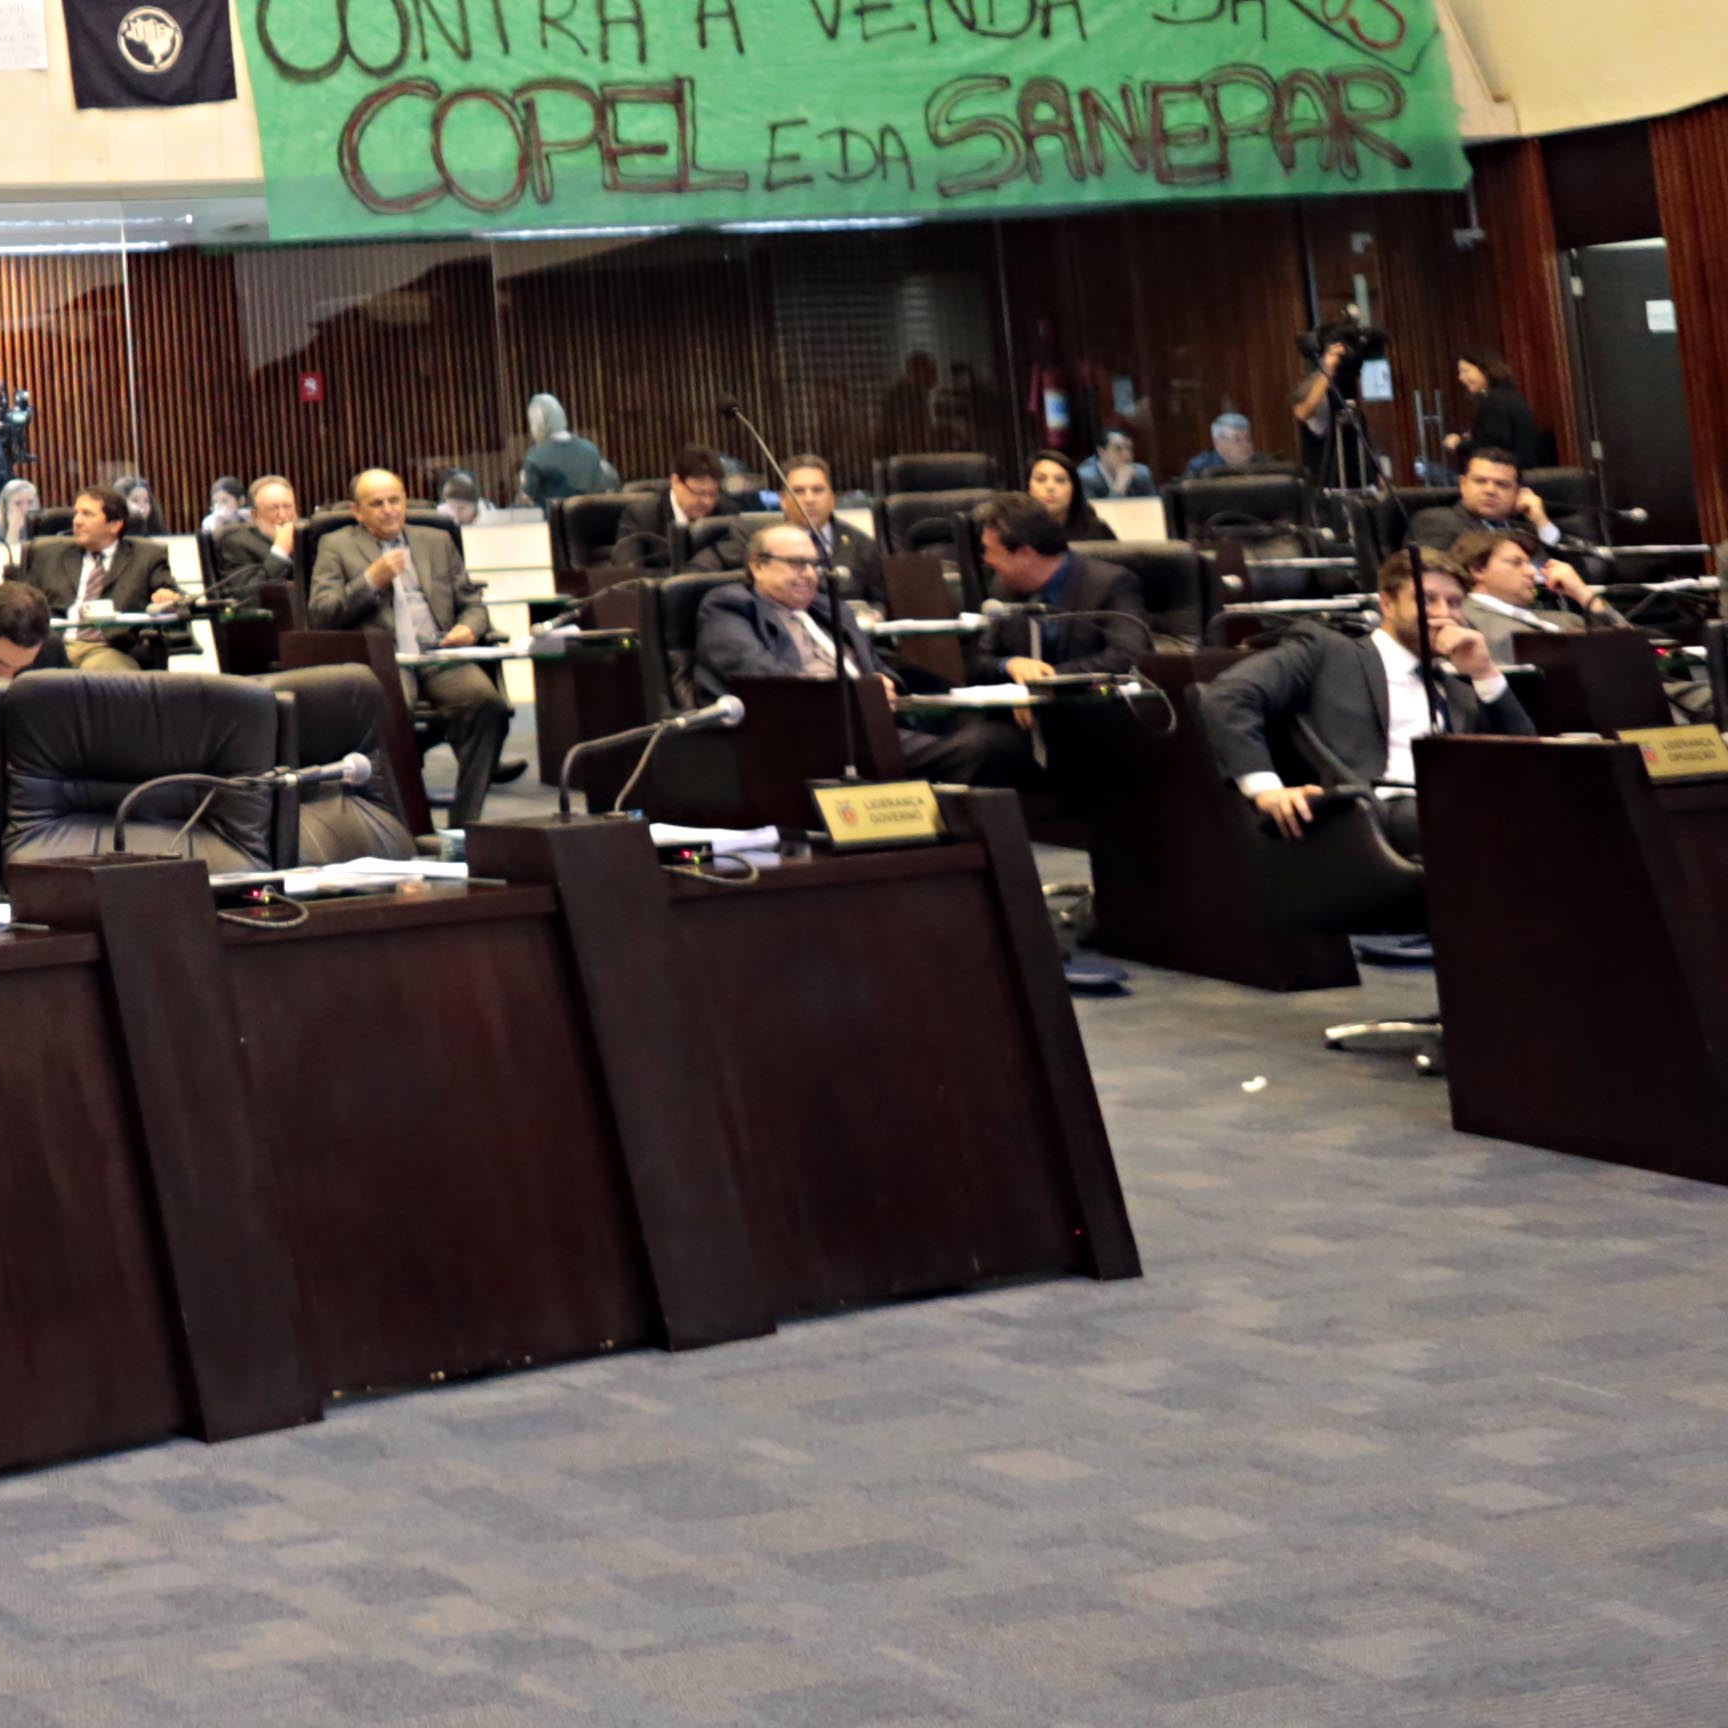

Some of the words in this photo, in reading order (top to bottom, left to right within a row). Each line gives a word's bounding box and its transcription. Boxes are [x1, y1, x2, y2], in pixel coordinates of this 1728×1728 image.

[338, 75, 750, 215] COPEL
[763, 119, 814, 191] E
[817, 123, 914, 191] DA
[925, 62, 1413, 198] SANEPAR
